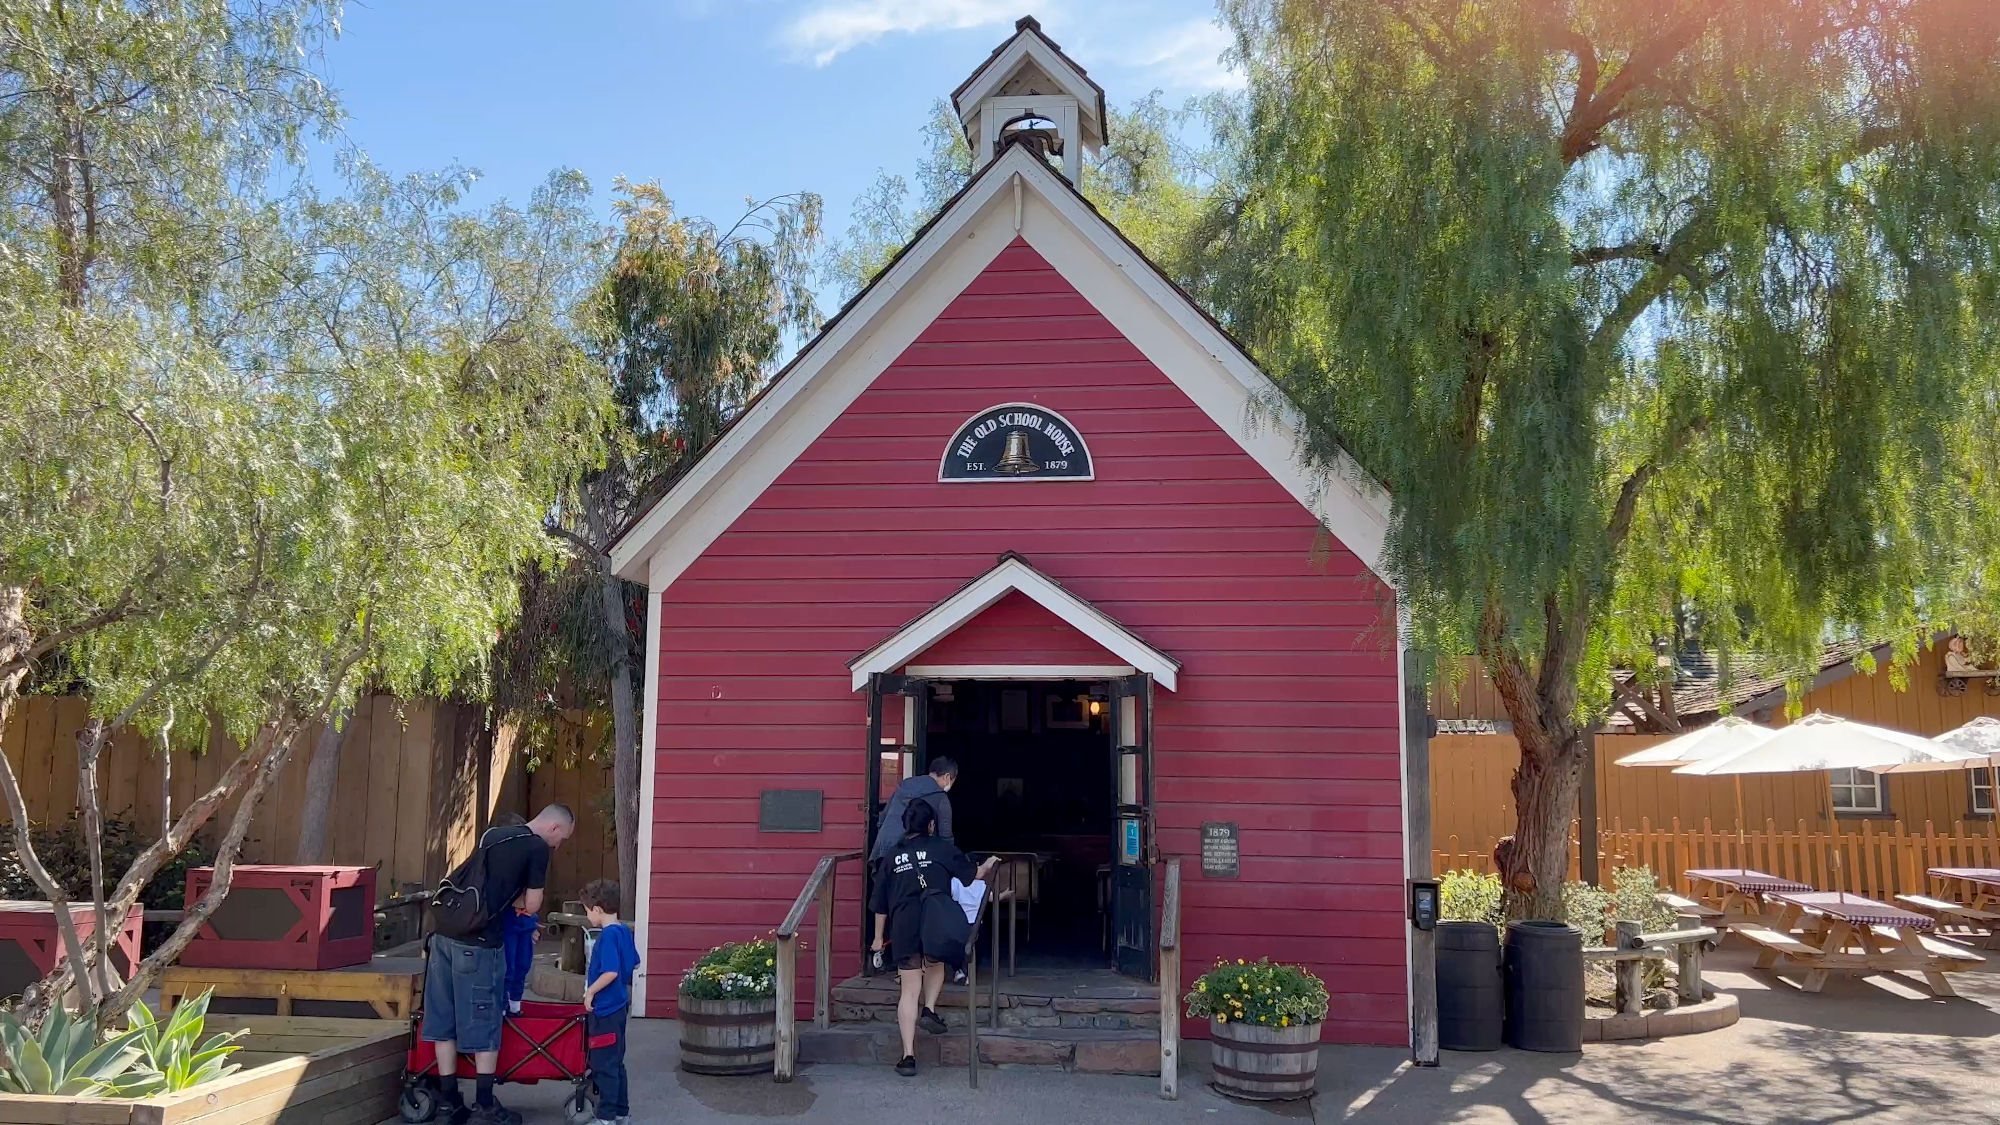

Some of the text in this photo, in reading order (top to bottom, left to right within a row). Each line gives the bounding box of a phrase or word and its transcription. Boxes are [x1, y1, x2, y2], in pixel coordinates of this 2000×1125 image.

[956, 412, 1075, 459] THE OLD SCHOOL HOUSE
[966, 460, 1068, 471] EST. 1879
[1210, 828, 1230, 836] 1879
[894, 851, 927, 865] CRW
